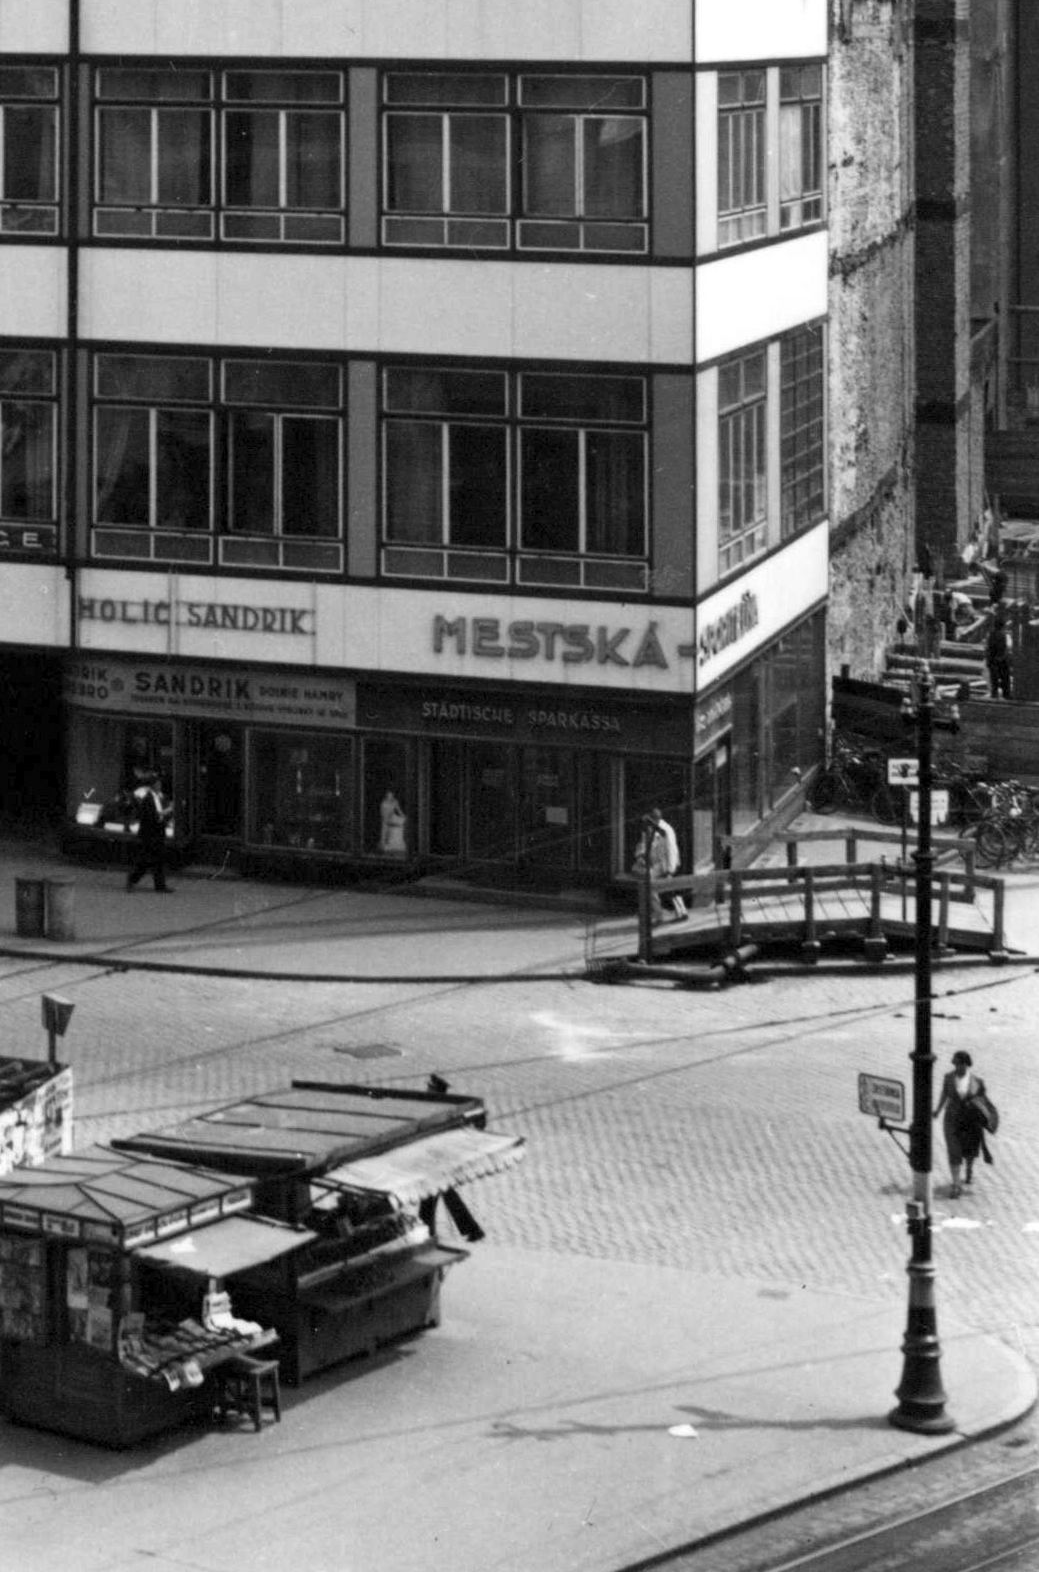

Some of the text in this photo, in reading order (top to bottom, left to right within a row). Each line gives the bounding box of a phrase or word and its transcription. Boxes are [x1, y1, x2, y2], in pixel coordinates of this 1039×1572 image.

[187, 602, 310, 635] SANDRIK
[433, 615, 669, 670] MESTSKÁ
[134, 671, 251, 700] SANDRIK
